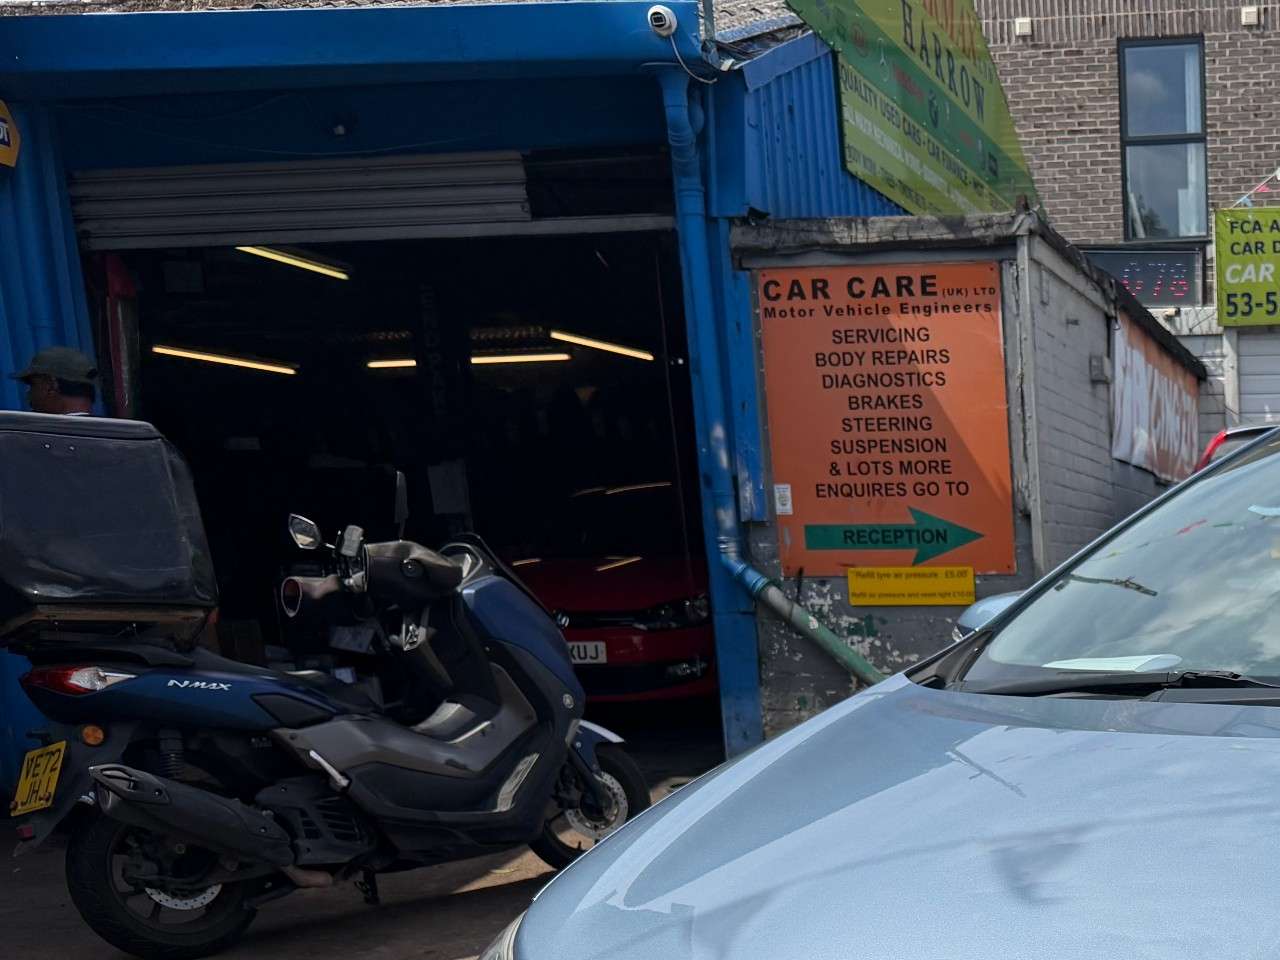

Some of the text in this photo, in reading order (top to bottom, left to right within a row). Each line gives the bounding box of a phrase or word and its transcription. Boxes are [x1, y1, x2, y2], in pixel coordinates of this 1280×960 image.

[901, 0, 985, 122] HARROW
[840, 63, 878, 109] QUALITY
[880, 100, 900, 129] USED
[1230, 219, 1263, 235] FCA
[1230, 240, 1264, 256] CAR
[1224, 264, 1276, 284] CAR
[763, 275, 996, 301] CAR CARE (UK) LTD
[764, 301, 992, 319] Motor Vehicle Engineers
[832, 327, 930, 344] SERVICING
[815, 349, 950, 368] BODY REPAIRS
[822, 371, 946, 389] DIAGNOSTICS
[848, 394, 923, 411] BRAKES
[842, 416, 932, 432] STEERING
[831, 438, 947, 455] SUSPENSION
[829, 459, 952, 477] & LOTS MORE
[815, 480, 969, 499] ENQUIRES GO TO
[843, 529, 948, 545] RECEPTION
[167, 679, 233, 691] NMAX
